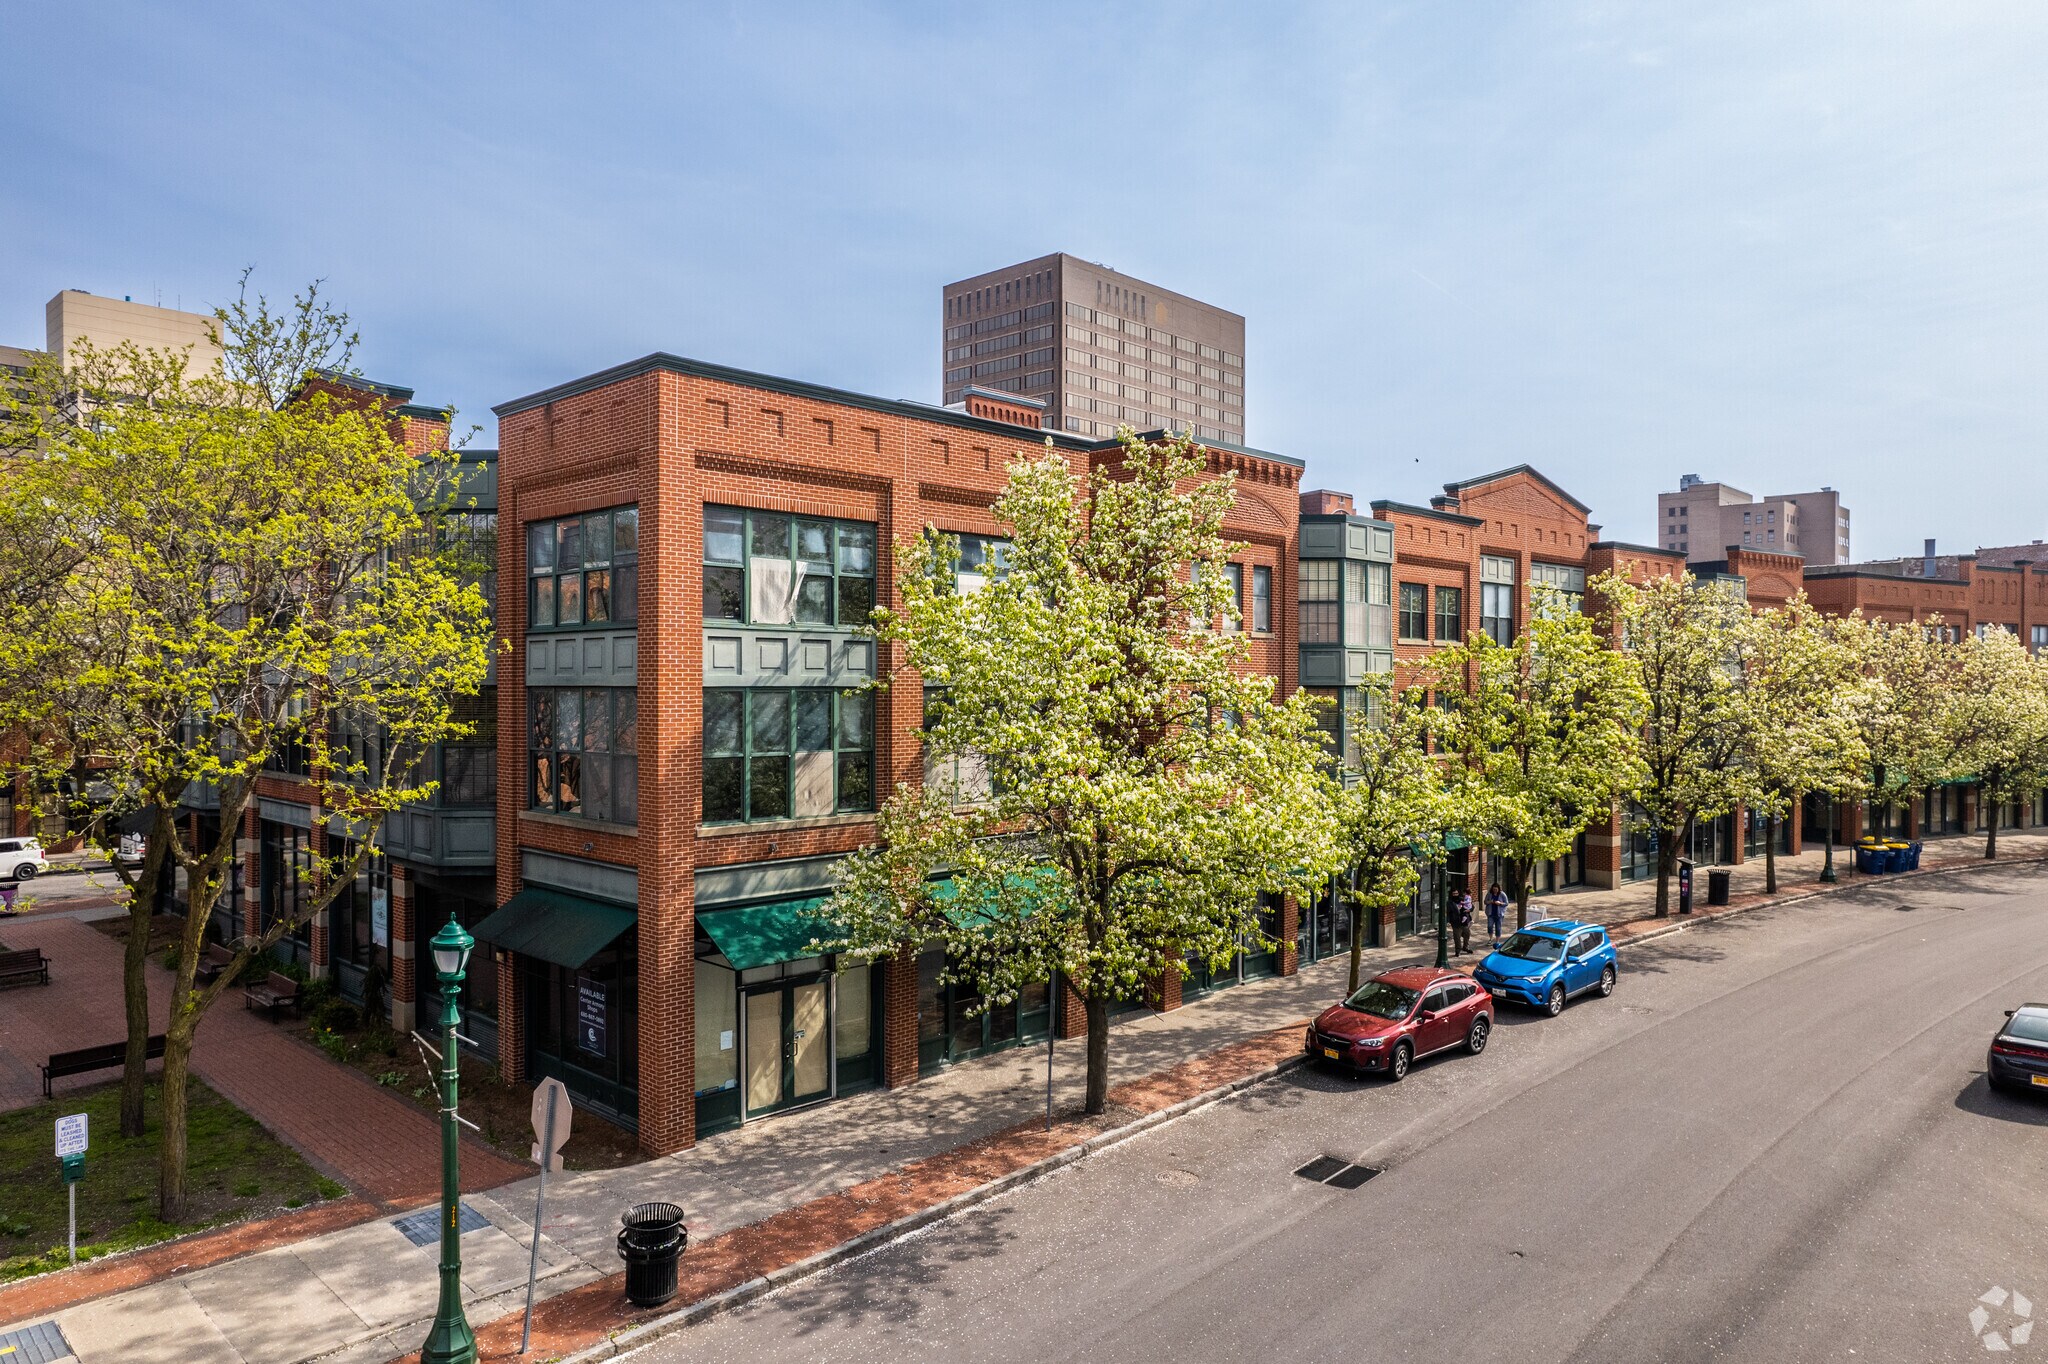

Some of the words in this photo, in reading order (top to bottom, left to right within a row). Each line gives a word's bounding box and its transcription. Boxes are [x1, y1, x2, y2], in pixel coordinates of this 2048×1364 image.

[580, 987, 605, 1001] AVAILABLE
[587, 1004, 598, 1013] Shops
[61, 1128, 82, 1137] LEASHED
[63, 1133, 85, 1142] CLEANED
